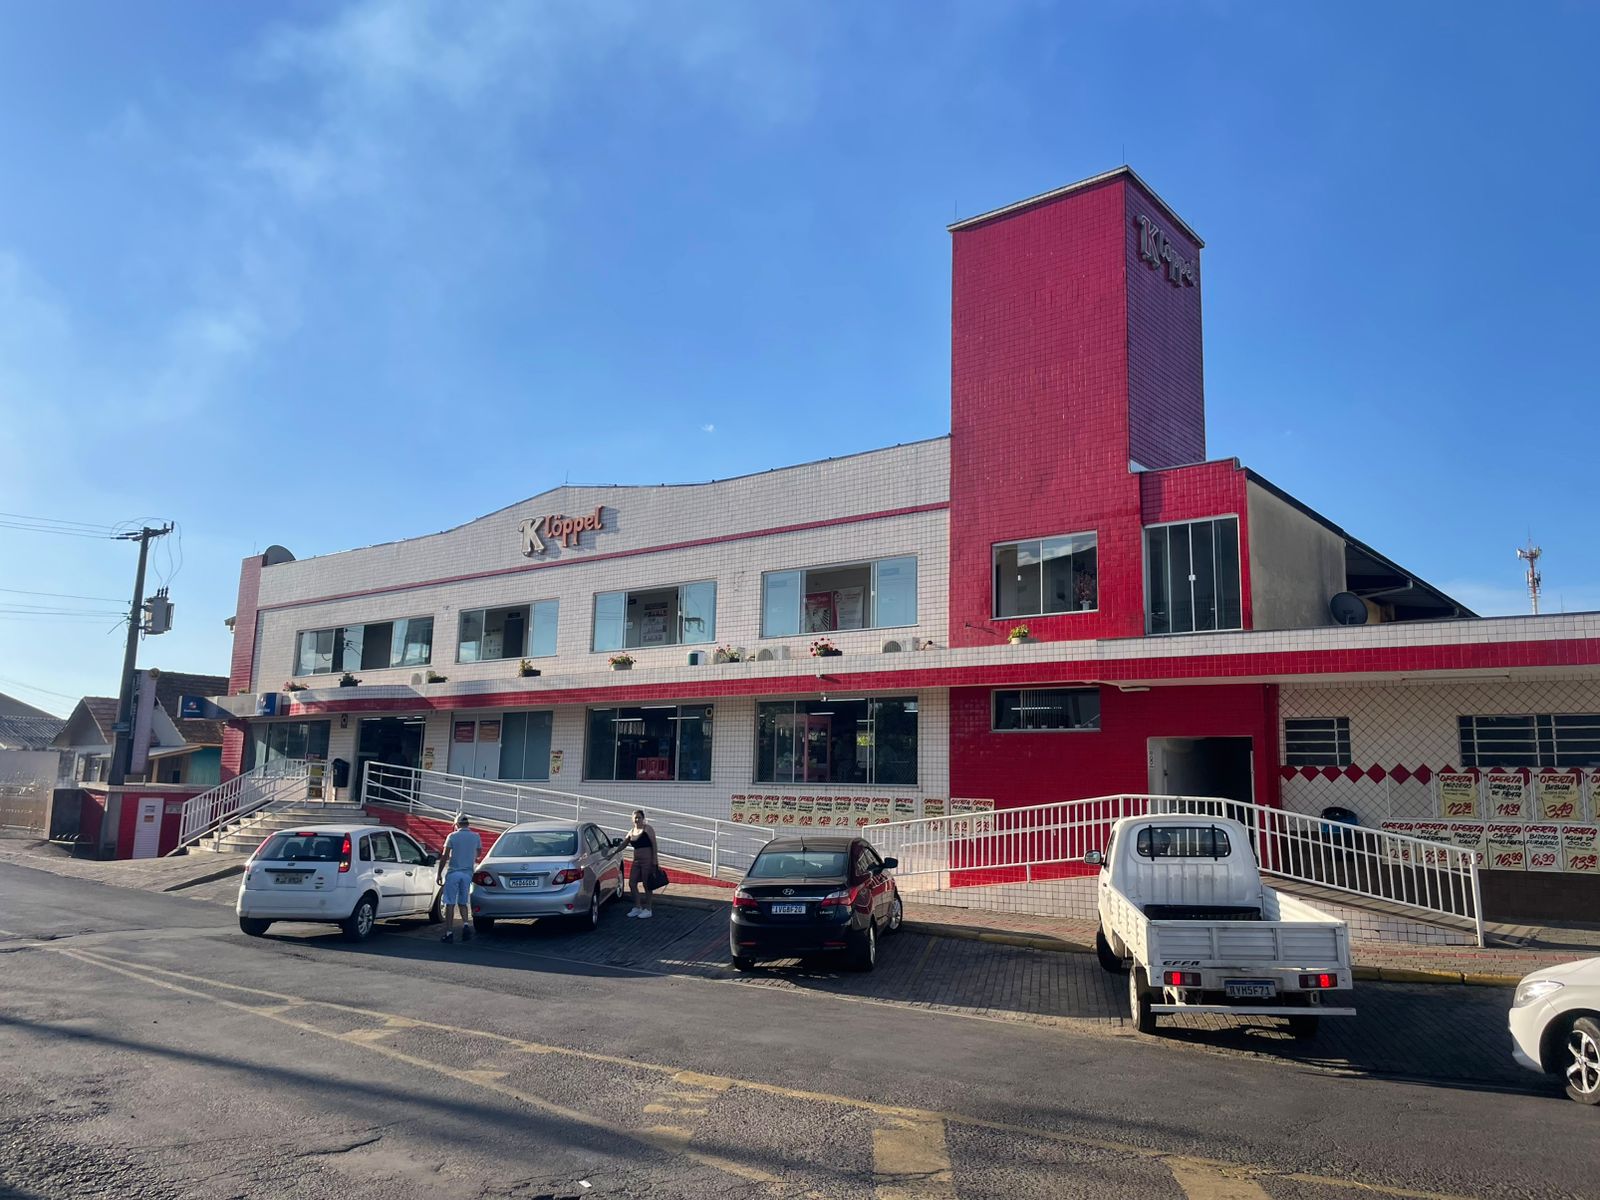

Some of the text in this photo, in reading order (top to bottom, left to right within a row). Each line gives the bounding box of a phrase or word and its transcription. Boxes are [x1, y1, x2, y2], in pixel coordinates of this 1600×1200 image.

[519, 505, 603, 557] Klöppel
[1440, 775, 1473, 783] OFERTA
[1488, 775, 1522, 783] OFERTA
[1540, 775, 1575, 785] OFERTA
[1382, 822, 1414, 831] OFERTA
[1415, 823, 1448, 831] OFERTA
[1451, 823, 1484, 833] OFERTA
[1488, 824, 1521, 834] OFERTA
[1524, 825, 1558, 834] OFERTA
[1562, 826, 1597, 836] OFERTA
